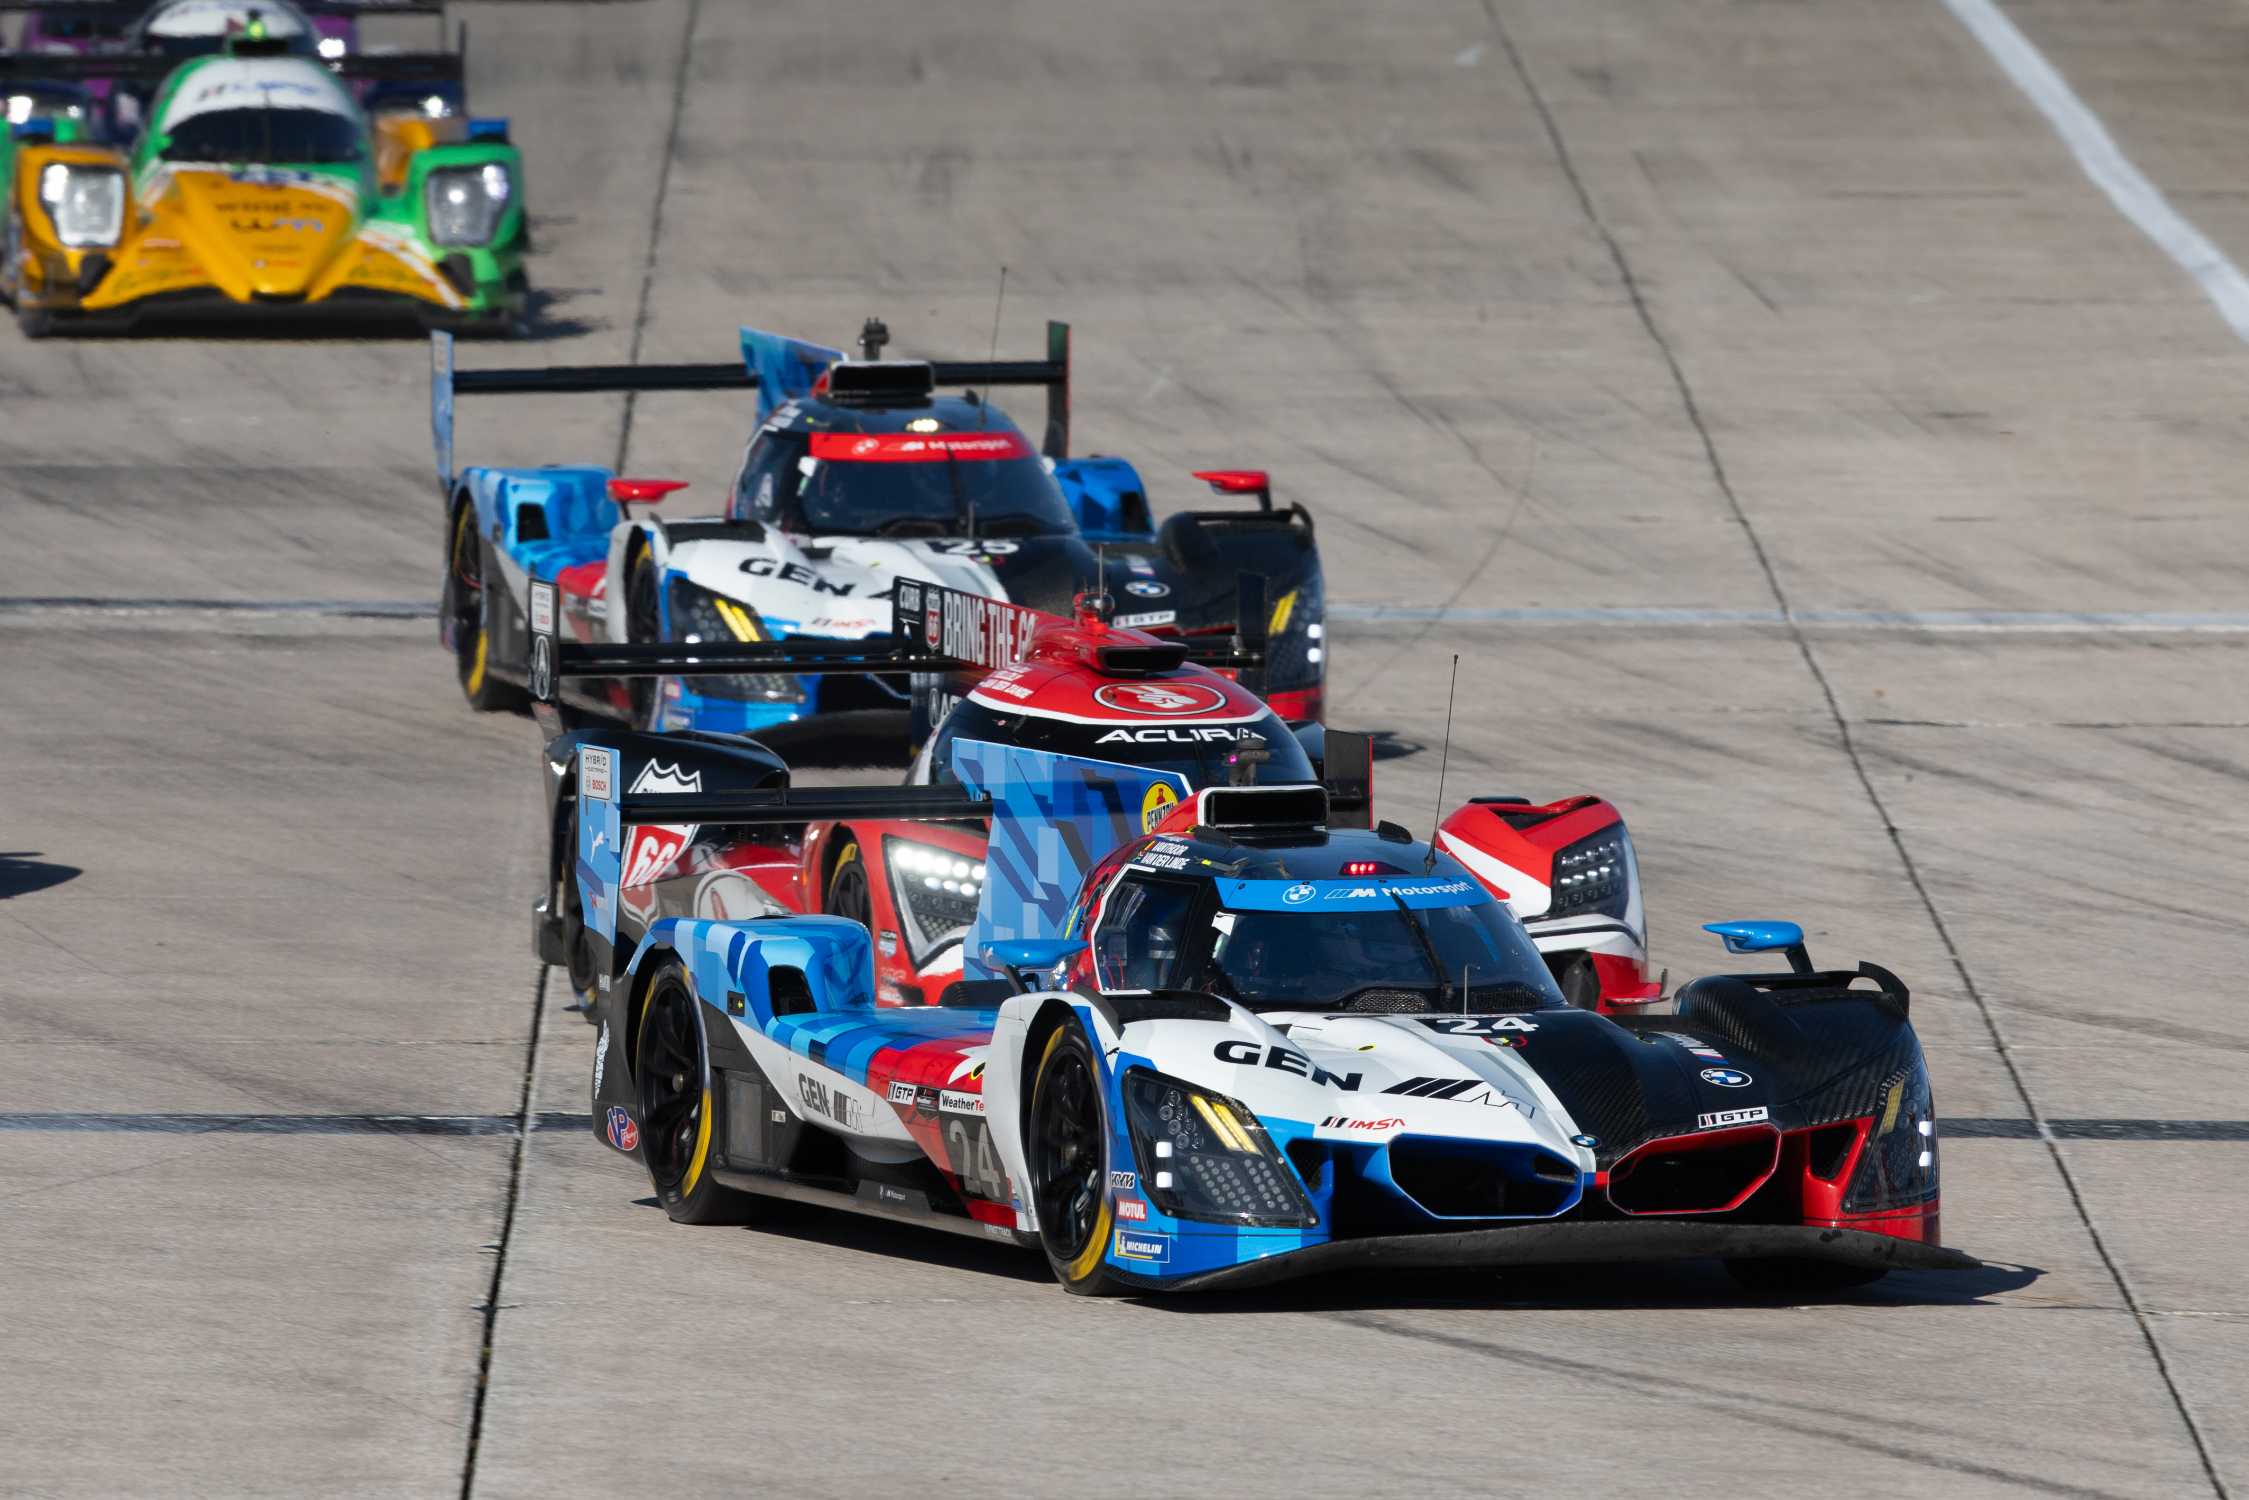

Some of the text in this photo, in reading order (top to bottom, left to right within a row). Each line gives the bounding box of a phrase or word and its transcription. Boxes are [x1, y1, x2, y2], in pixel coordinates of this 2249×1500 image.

[939, 540, 1019, 554] 25
[738, 557, 857, 597] GEN
[943, 590, 985, 666] BRING
[987, 603, 1015, 670] THE
[622, 836, 677, 892] 66
[1382, 881, 1474, 897] Motorsport
[1436, 1016, 1540, 1034] 24
[1213, 1040, 1363, 1092] GEN
[798, 1073, 831, 1118] GEN
[895, 1086, 915, 1103] GTP
[1347, 1118, 1406, 1130] IMSA
[1720, 1109, 1763, 1122] GTP
[949, 1120, 1001, 1198] 24
[1119, 1201, 1146, 1219] MOTUL
[1126, 1241, 1163, 1254] MICHELIN
